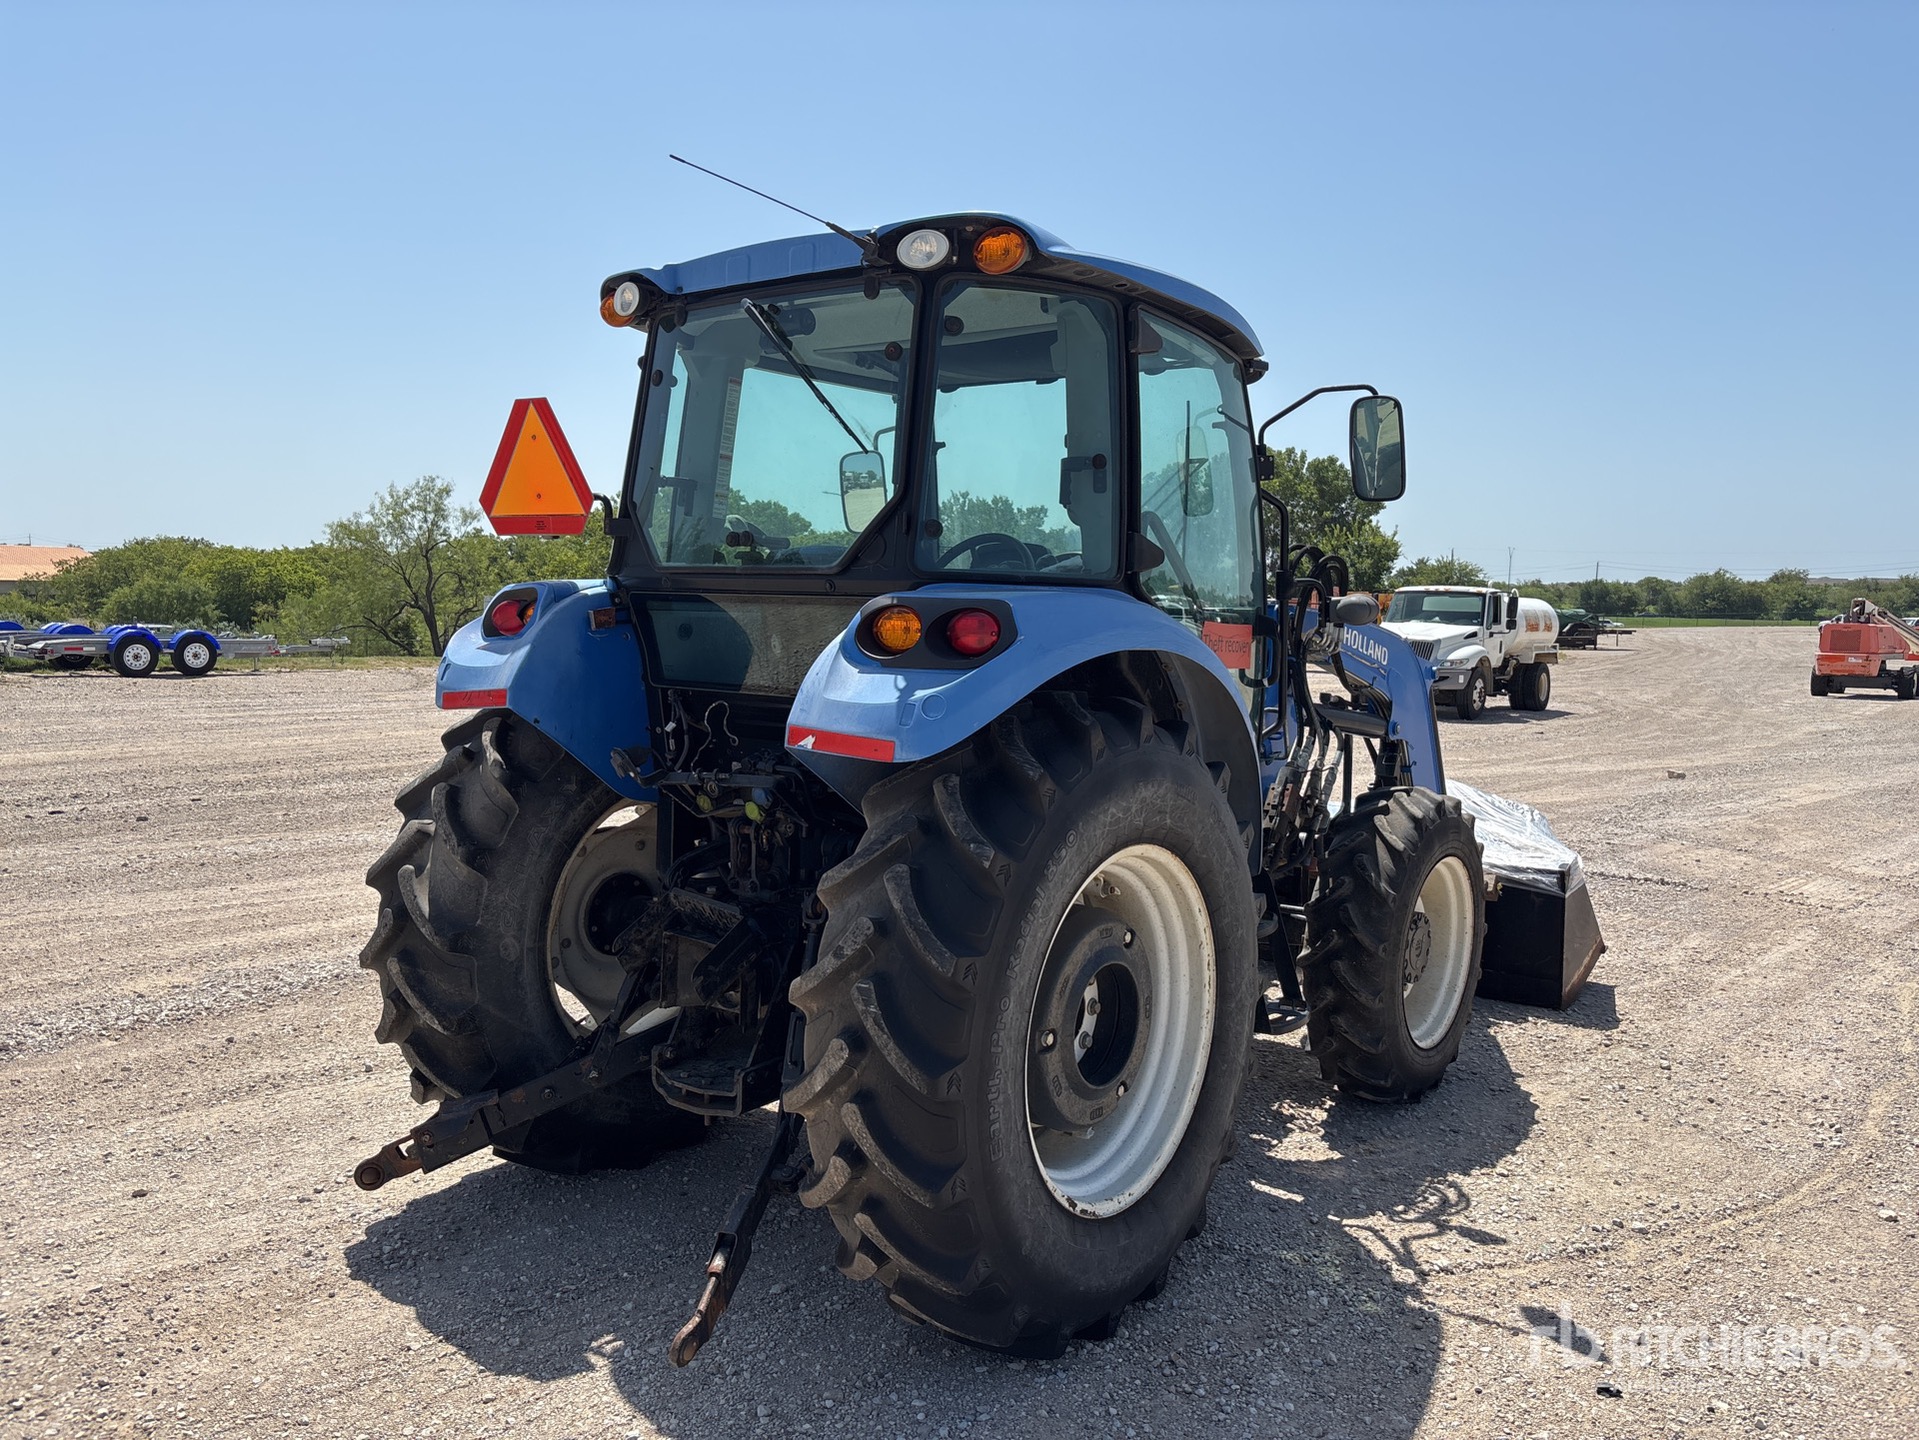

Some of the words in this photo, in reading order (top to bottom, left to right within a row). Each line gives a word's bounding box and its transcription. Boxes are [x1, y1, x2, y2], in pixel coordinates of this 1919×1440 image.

[1203, 634, 1224, 653] Theft
[1343, 626, 1389, 666] HOLLAND
[986, 994, 1012, 1162] Earth-Pro
[1005, 885, 1045, 980] Radial
[1044, 828, 1079, 881] 850
